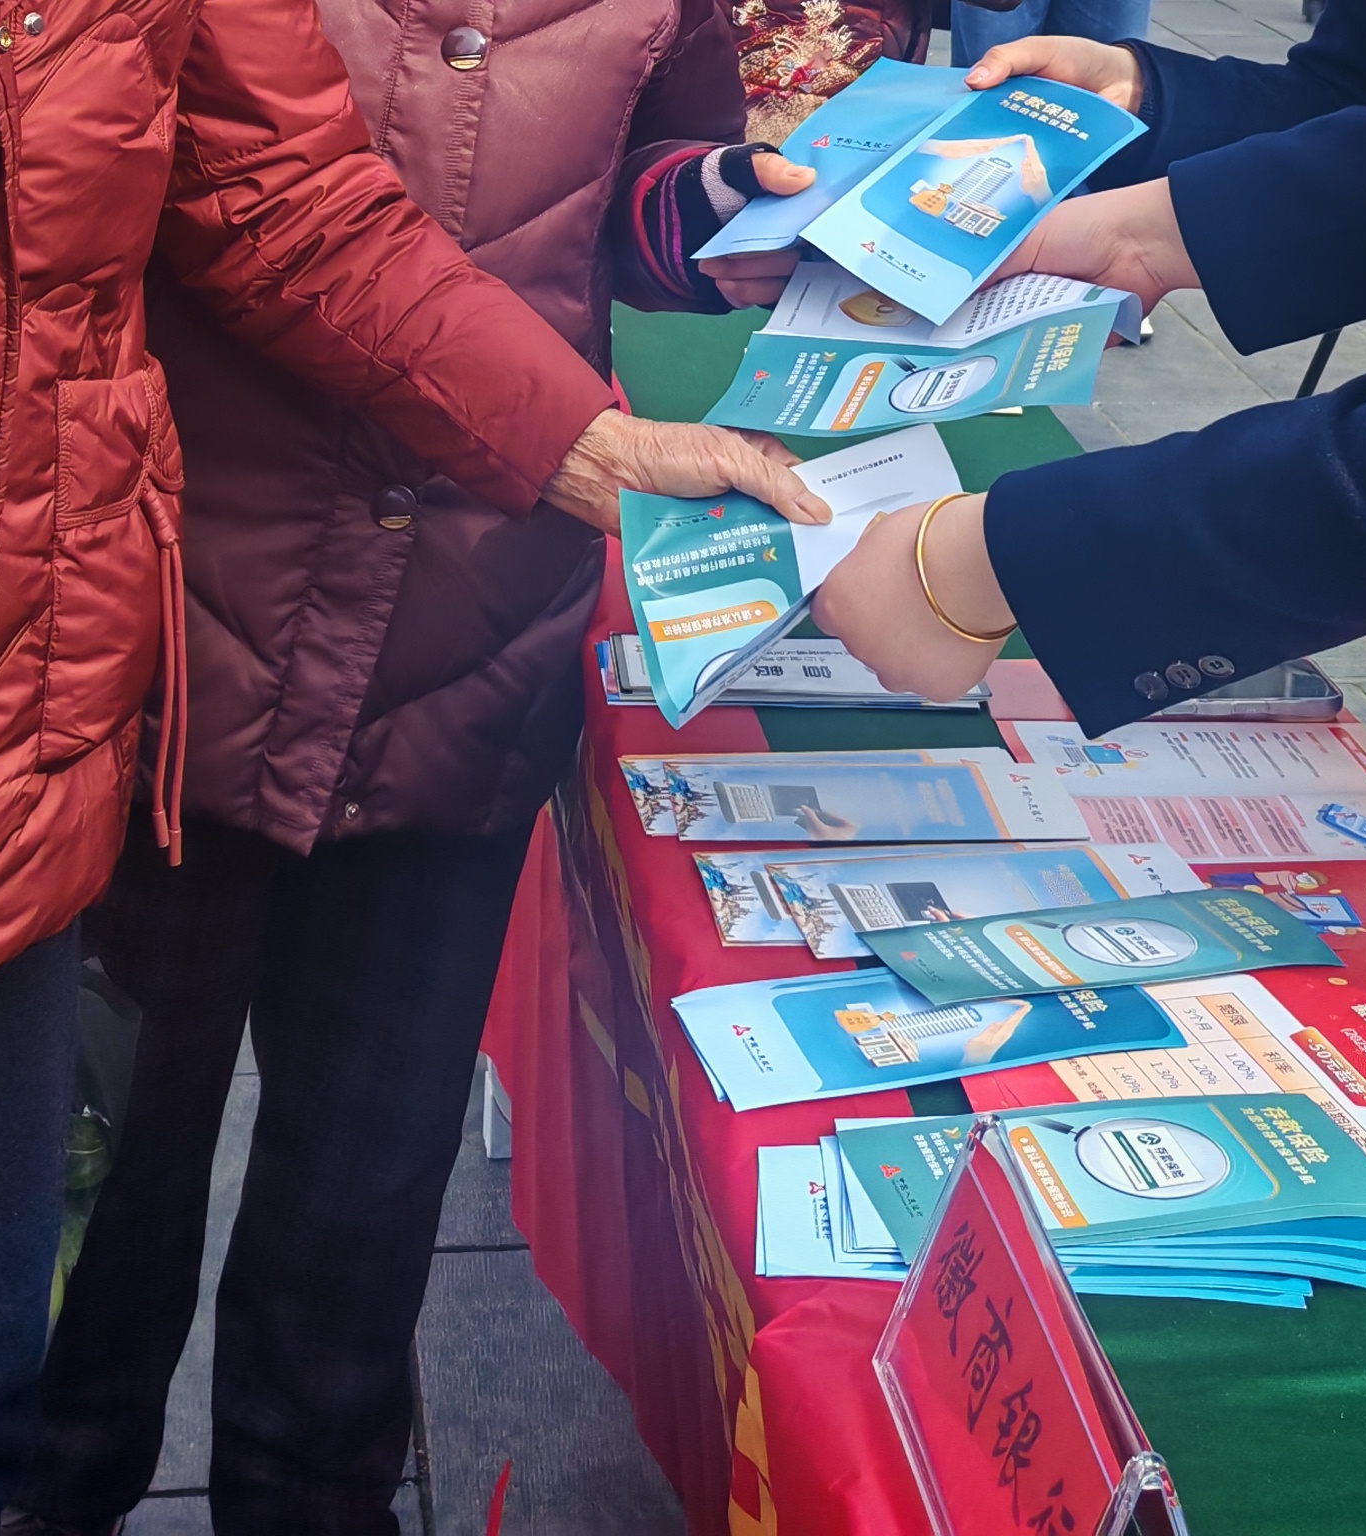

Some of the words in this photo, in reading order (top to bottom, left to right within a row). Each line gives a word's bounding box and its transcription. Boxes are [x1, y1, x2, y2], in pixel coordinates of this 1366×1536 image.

[1008, 89, 1080, 125] 存款保险
[1046, 322, 1084, 373] 存款保险
[662, 608, 753, 637] 请认准存款保险标识
[1214, 897, 1281, 938] 存款保险
[1057, 993, 1097, 1030] 保驾护航
[1183, 1007, 1213, 1031] 3个月
[1216, 1003, 1249, 1027] 期限
[1187, 1057, 1220, 1085] 1.20%
[1224, 1052, 1258, 1081] 1.00%
[1262, 1050, 1295, 1074] 利率
[1260, 1105, 1331, 1165] 存款保险
